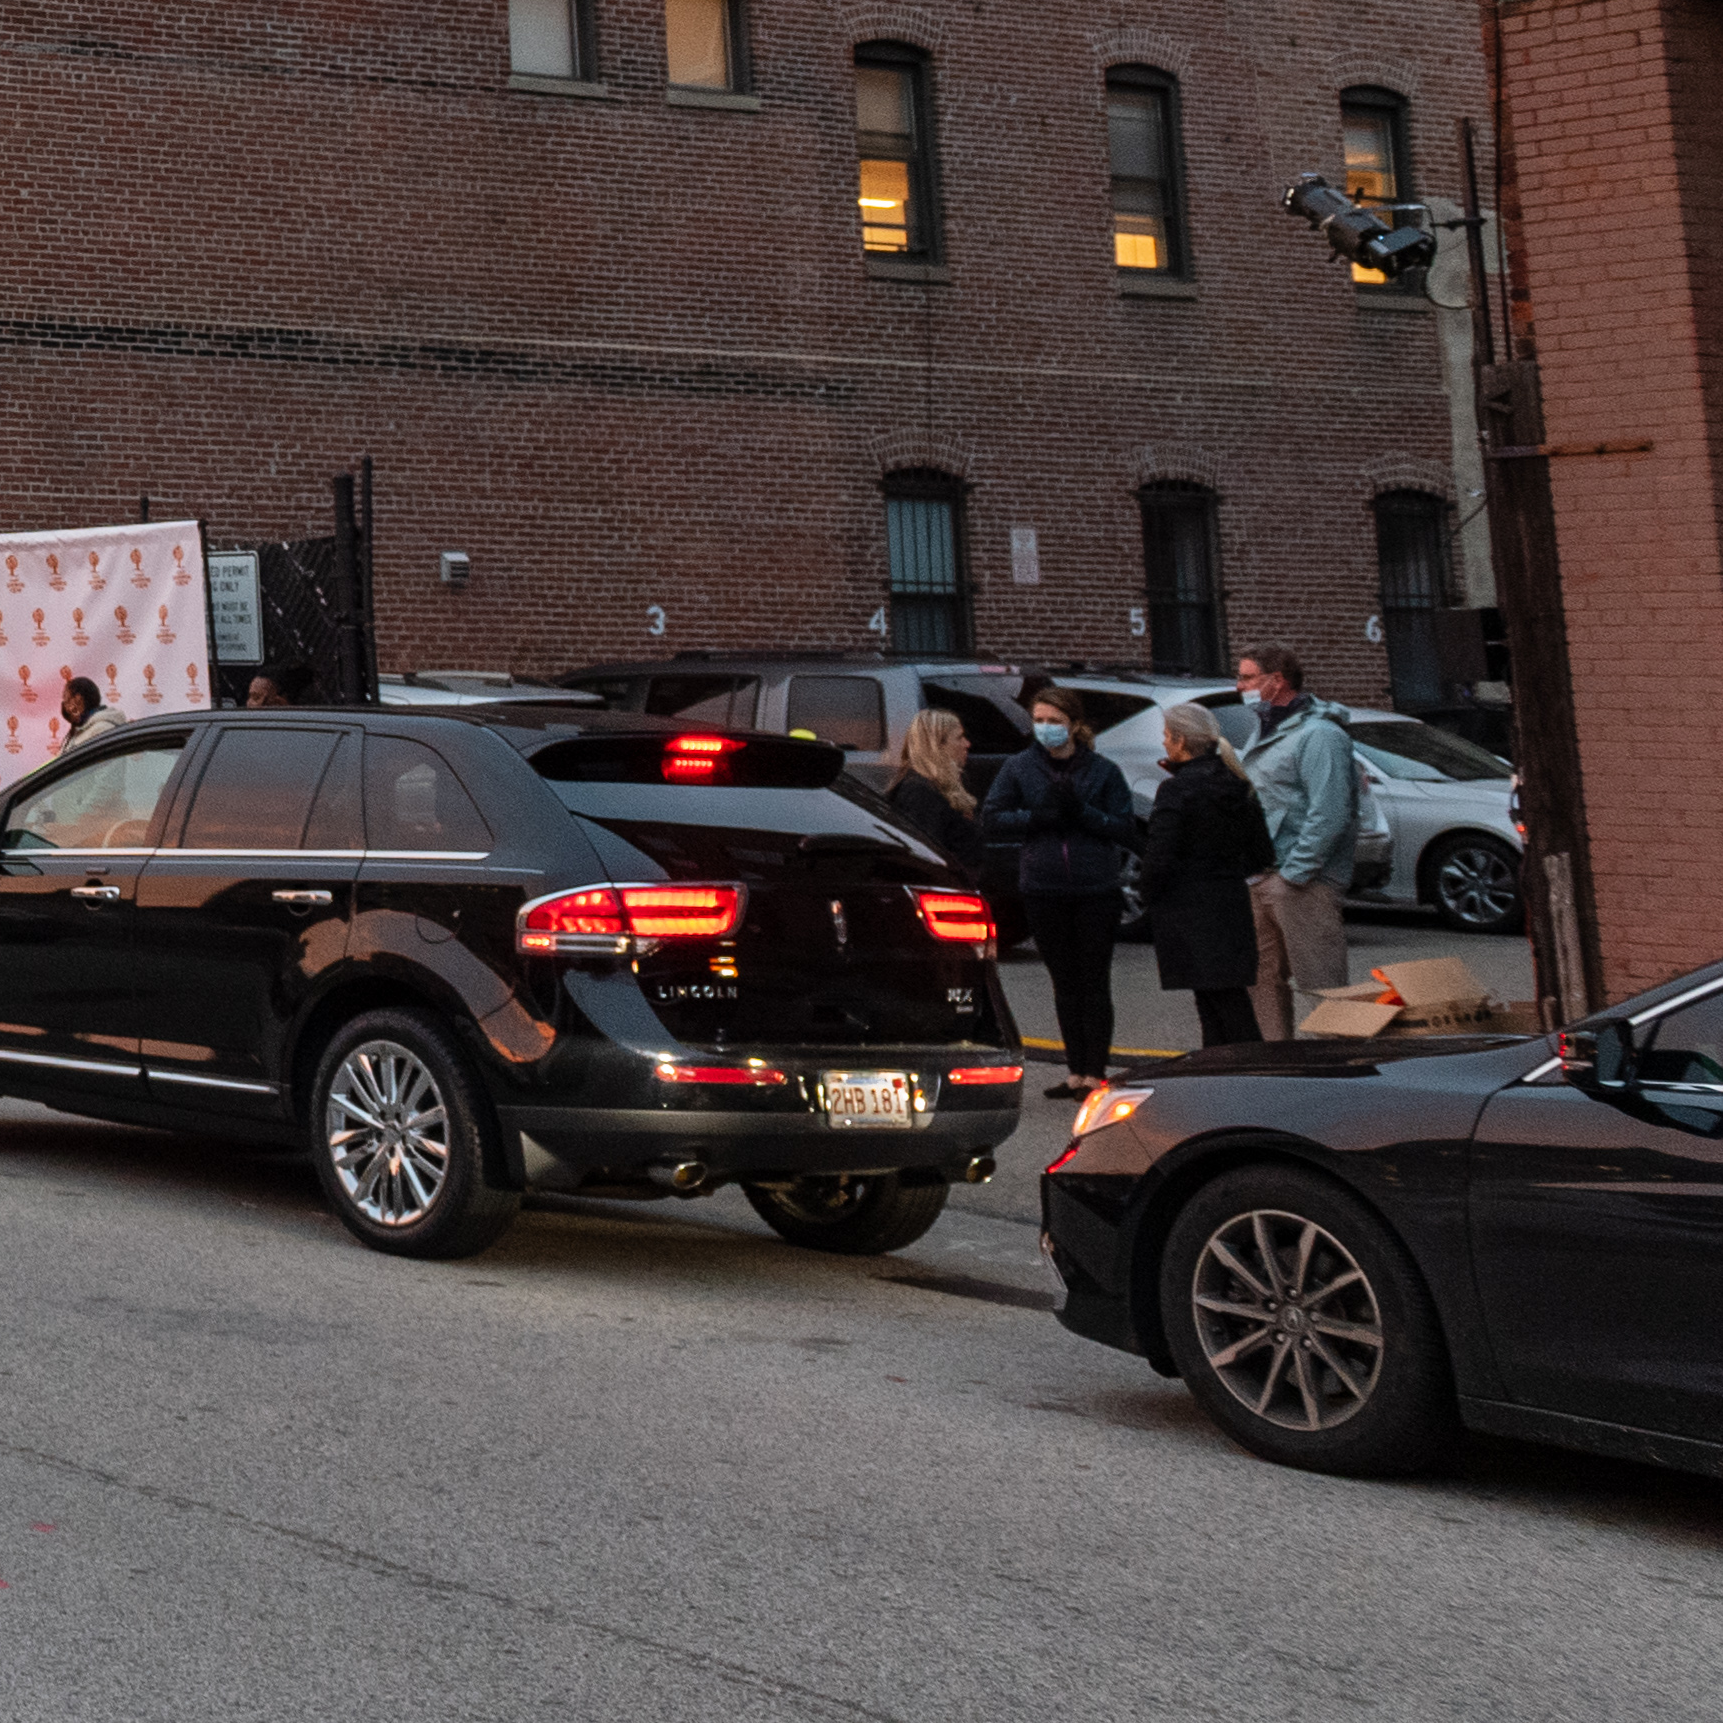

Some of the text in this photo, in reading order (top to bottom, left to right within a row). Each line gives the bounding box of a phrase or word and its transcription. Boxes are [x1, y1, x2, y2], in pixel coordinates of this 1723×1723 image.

[646, 605, 665, 635] 3
[868, 607, 888, 637] 4
[1130, 607, 1146, 637] 5
[1365, 614, 1382, 643] 6
[658, 985, 738, 999] LINCOLN
[830, 1087, 903, 1116] 2HB 181
